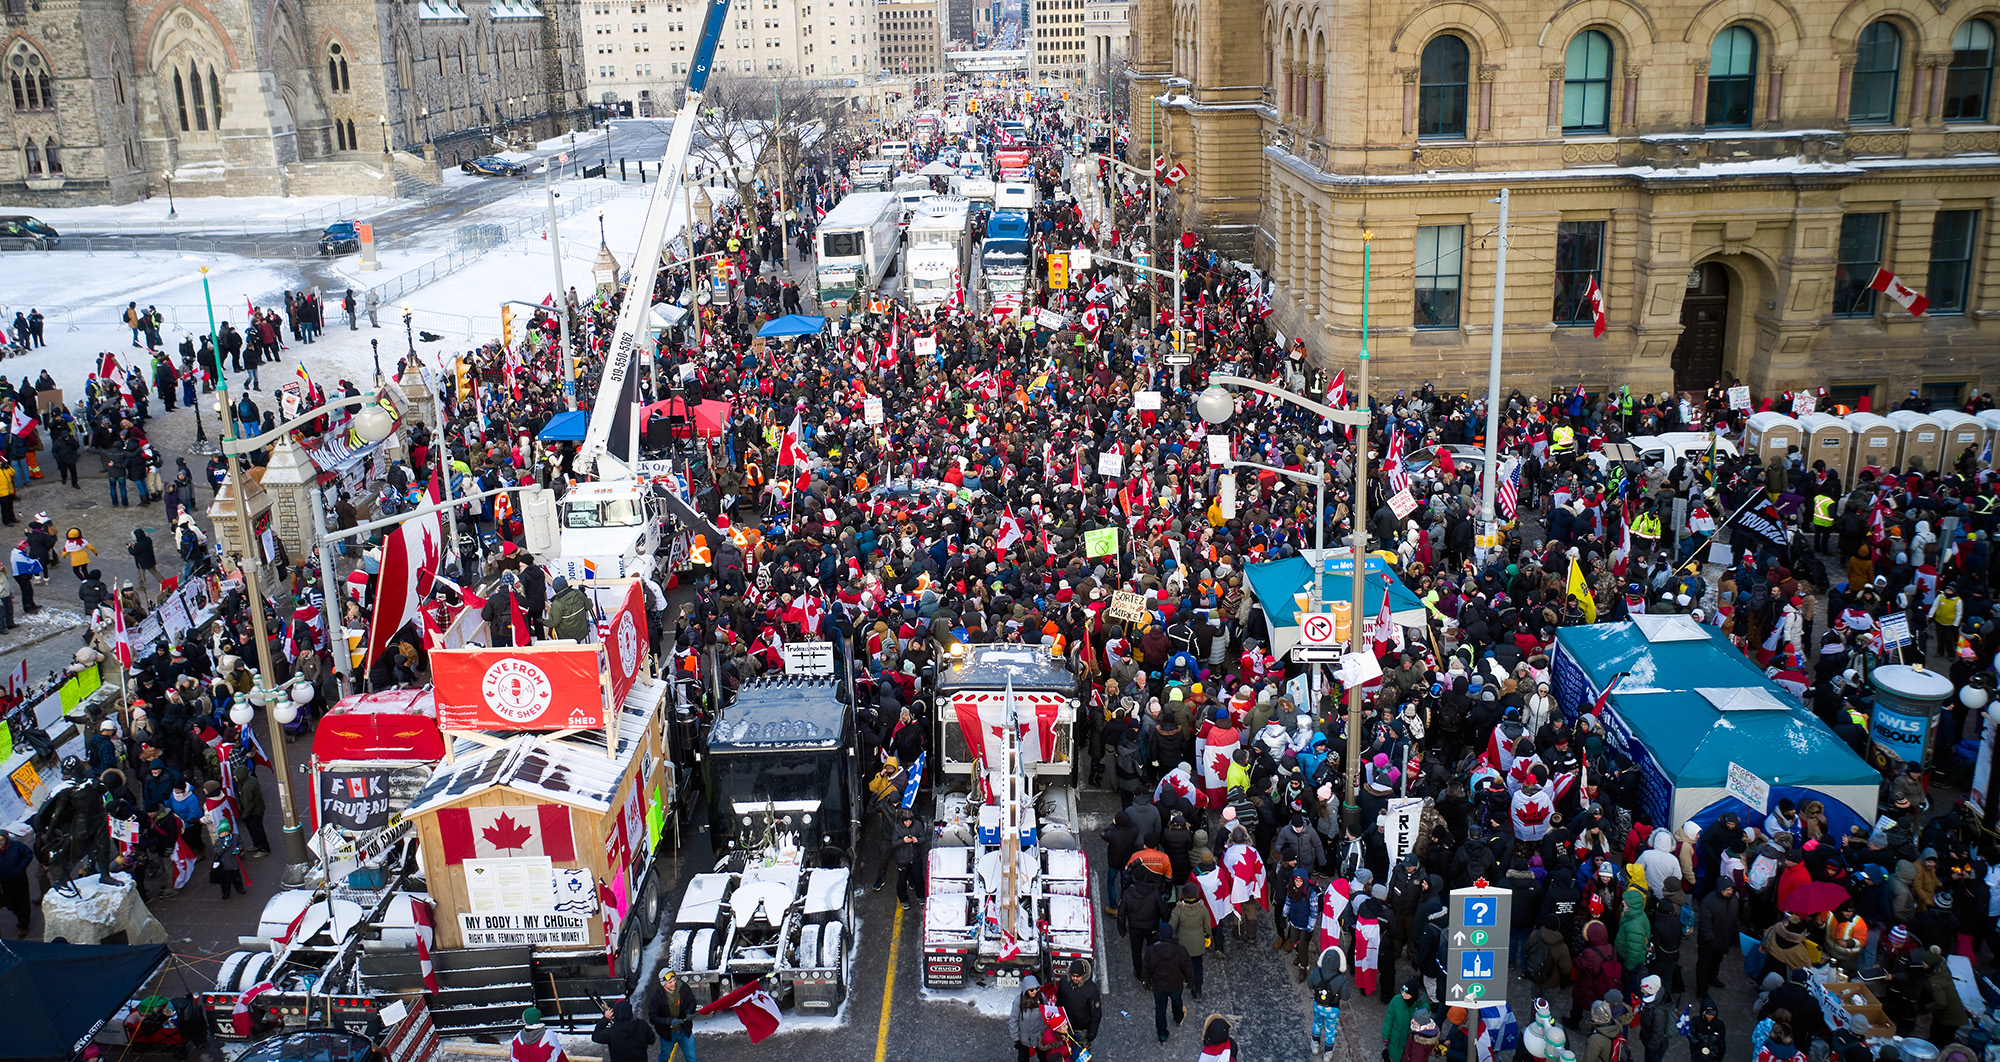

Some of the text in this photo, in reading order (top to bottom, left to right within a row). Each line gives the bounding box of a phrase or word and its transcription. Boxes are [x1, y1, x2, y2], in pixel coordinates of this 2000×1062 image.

[611, 332, 634, 382] 519-550-5362
[1738, 511, 1787, 546] TRUDEAU
[1114, 592, 1144, 605] SORTEZ
[1110, 608, 1144, 622] MATRICE!
[486, 662, 544, 686] LIVE FROM
[496, 702, 542, 719] THE SHED
[568, 716, 596, 724] SHED
[1878, 712, 1920, 732] OWLS
[1873, 721, 1922, 744] HIBOUX
[324, 798, 388, 817] TRUDEAU
[465, 916, 480, 929] MY
[485, 916, 510, 928] BODY
[524, 916, 539, 928] MY
[544, 915, 584, 927] CHOICE!
[468, 933, 484, 944] RIGHT
[485, 933, 497, 943] MR.
[498, 932, 525, 943] FEMINIST?
[526, 932, 548, 942] FOLLOW
[549, 932, 560, 942] THE
[561, 932, 580, 942] MONEY
